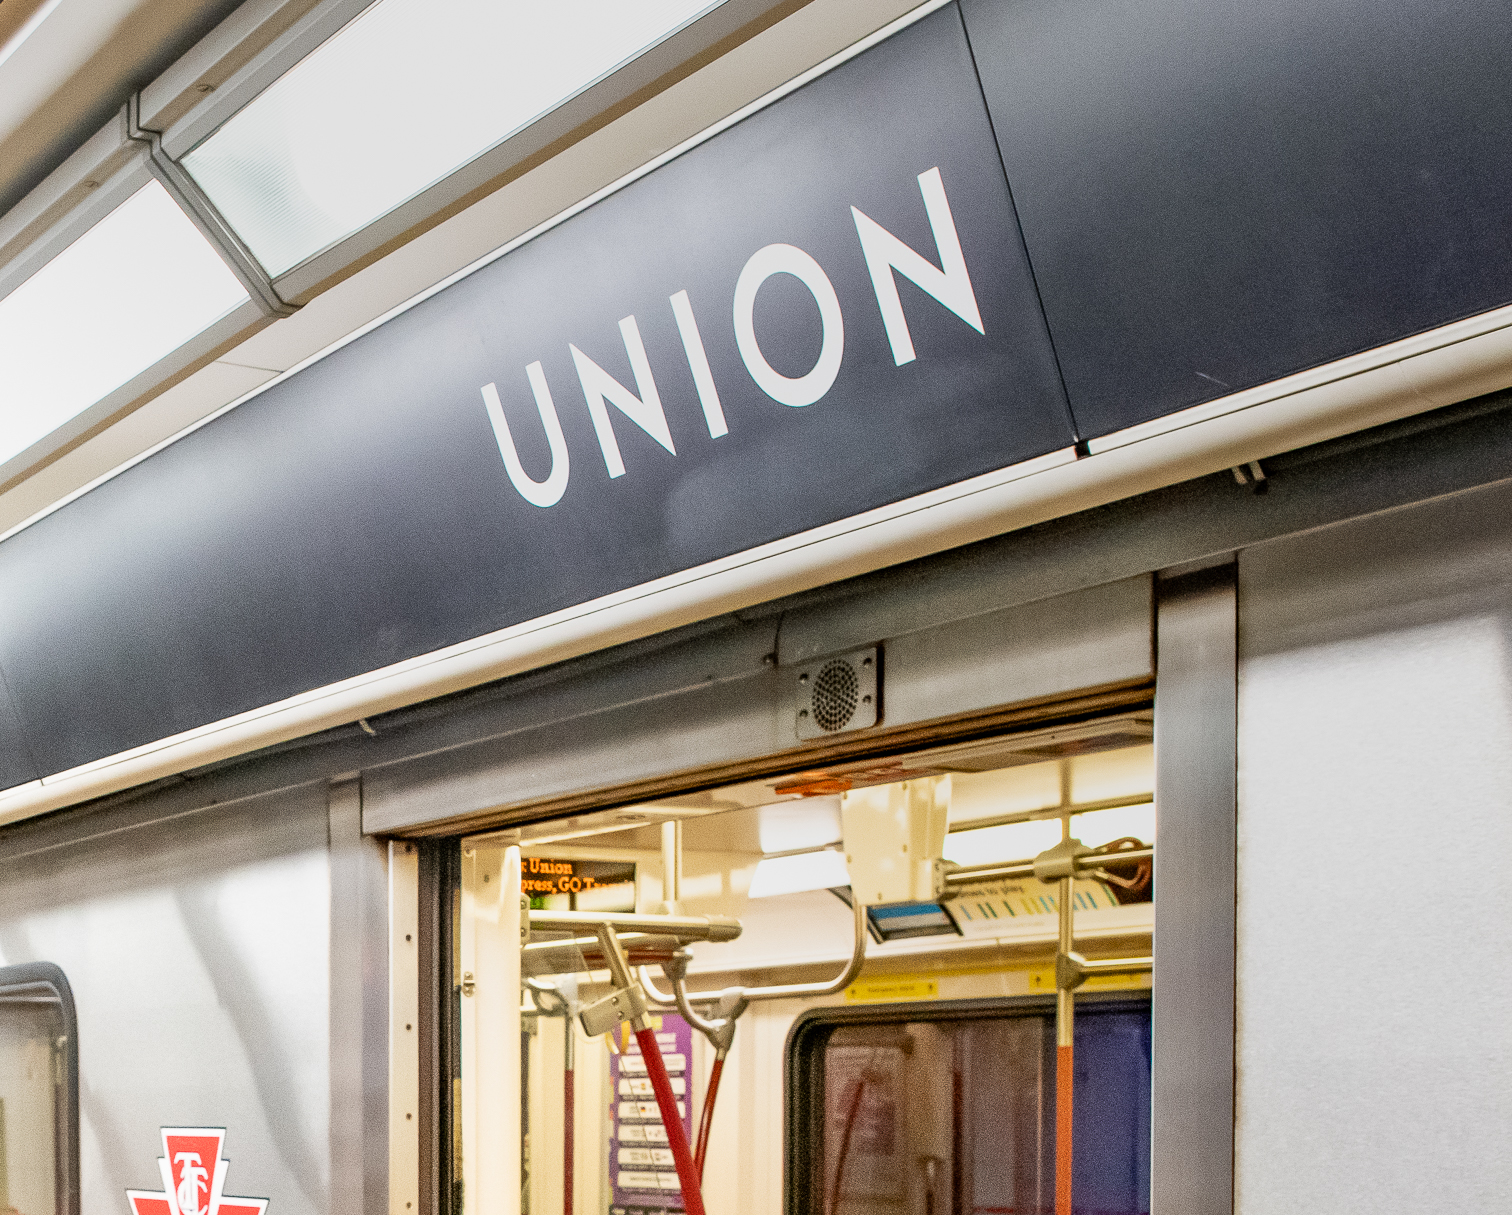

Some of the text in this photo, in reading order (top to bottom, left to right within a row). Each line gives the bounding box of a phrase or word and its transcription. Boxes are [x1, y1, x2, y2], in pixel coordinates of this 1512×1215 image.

[481, 166, 986, 508] UNION
[529, 857, 573, 875] Union
[558, 876, 582, 893] GO
